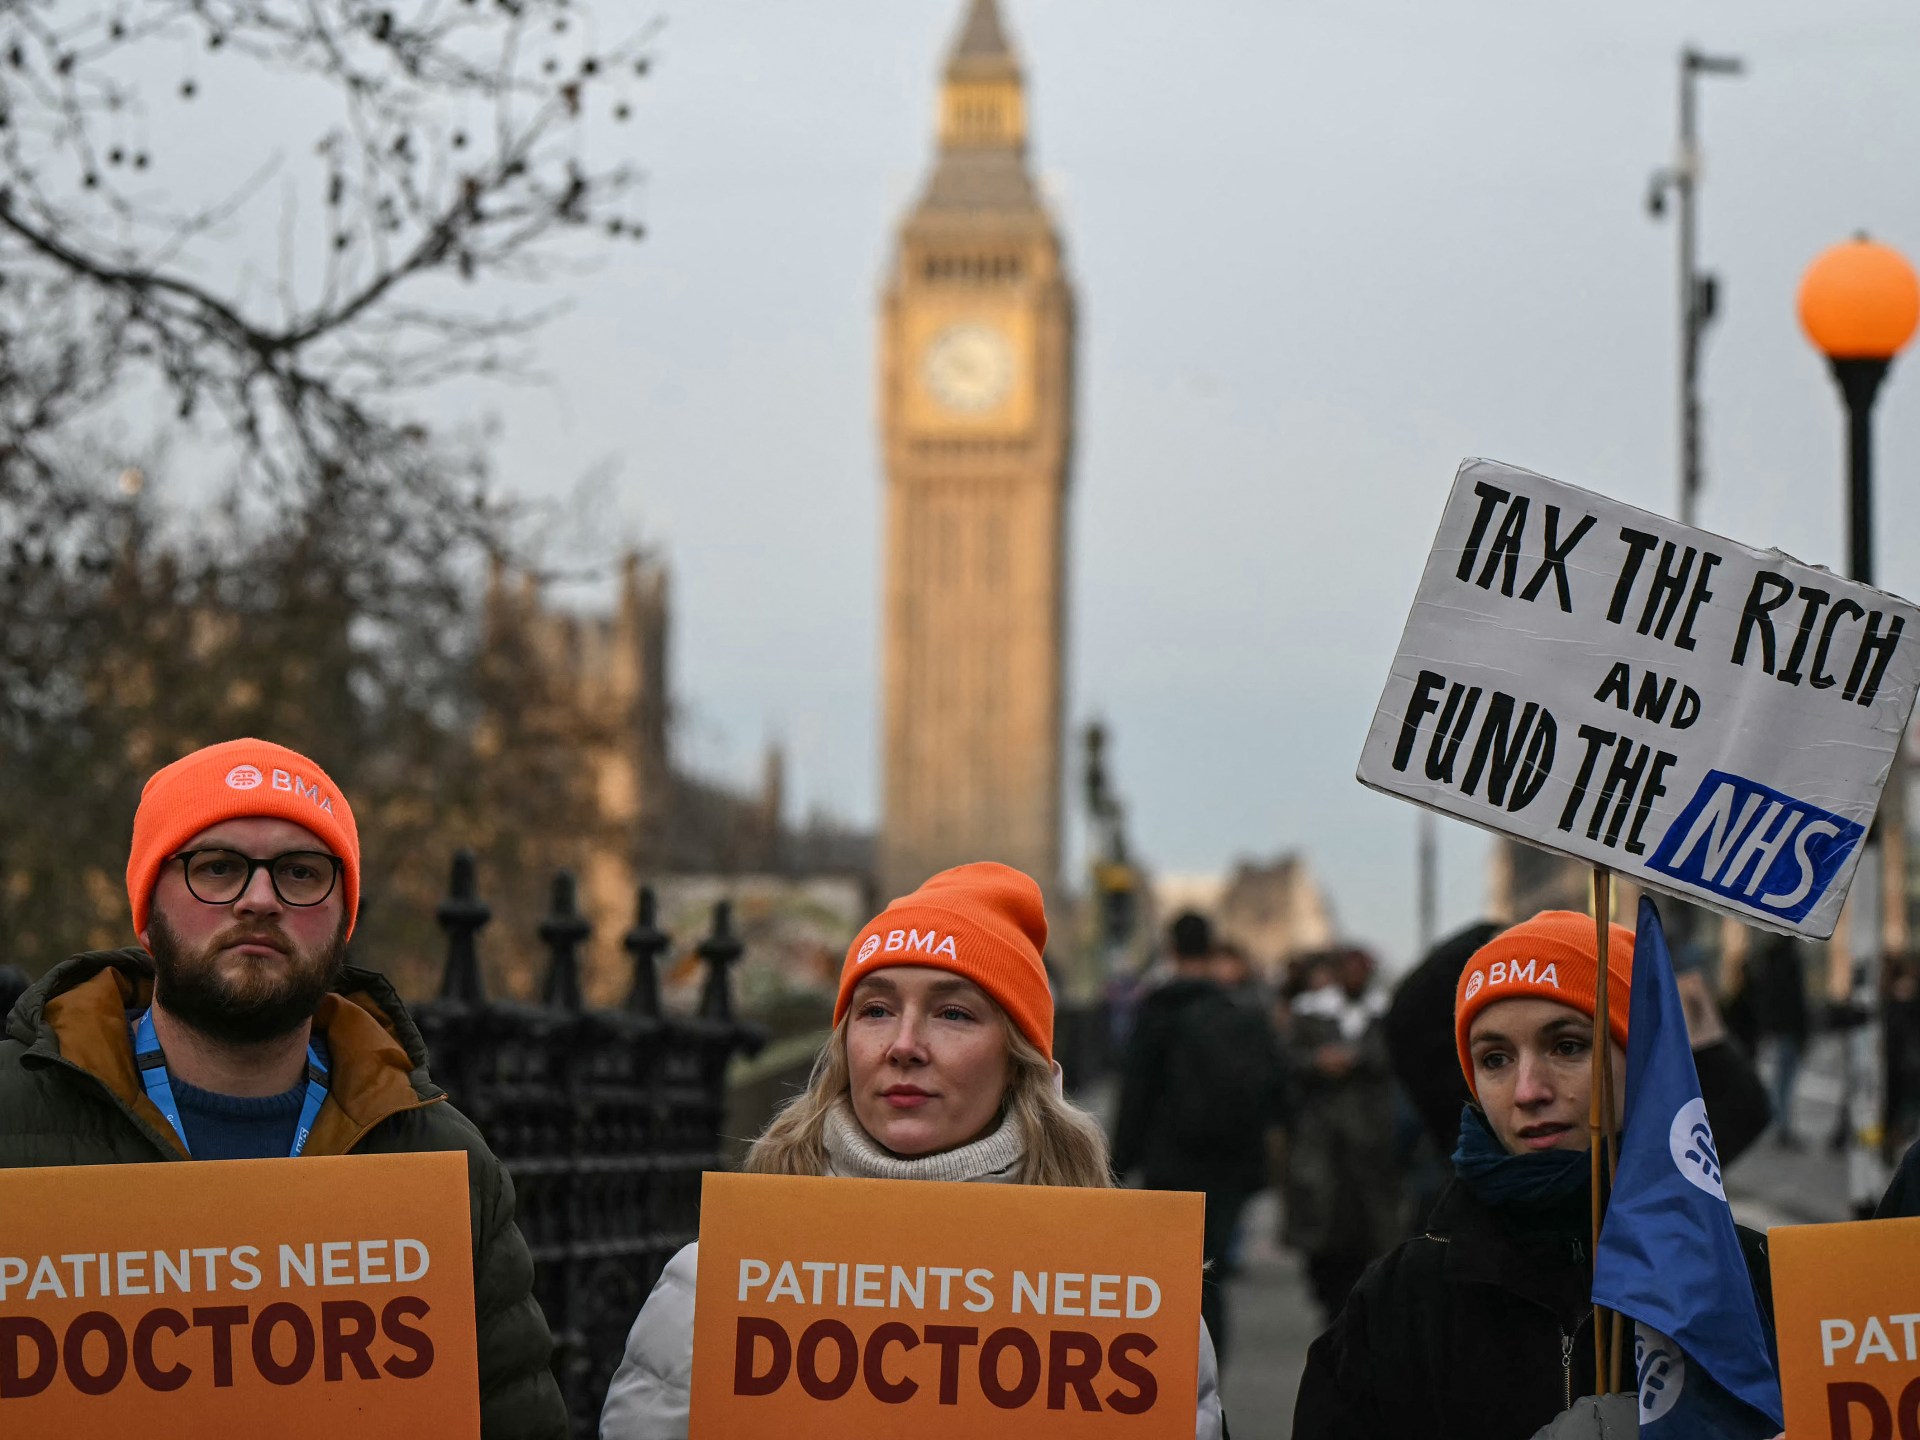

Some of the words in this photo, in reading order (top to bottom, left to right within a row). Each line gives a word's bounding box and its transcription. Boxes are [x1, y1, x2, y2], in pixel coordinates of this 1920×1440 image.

[1456, 481, 1597, 613] TAX
[1607, 527, 1722, 652] THE
[1731, 571, 1904, 707] RICH
[1594, 662, 1701, 729] AND
[272, 769, 336, 819] BMA
[1392, 670, 1557, 812] FUND
[1558, 725, 1677, 856] THE
[1669, 783, 1839, 908] NHS
[884, 929, 956, 961] BMA
[1488, 960, 1559, 988] BMA
[0, 1246, 262, 1302] PATIENTS
[278, 1239, 430, 1288] NEED
[738, 1259, 994, 1312] PATIENTS
[1011, 1271, 1162, 1319] NEED
[0, 1296, 435, 1399] DOCTORS
[734, 1317, 1158, 1415] DOCTORS
